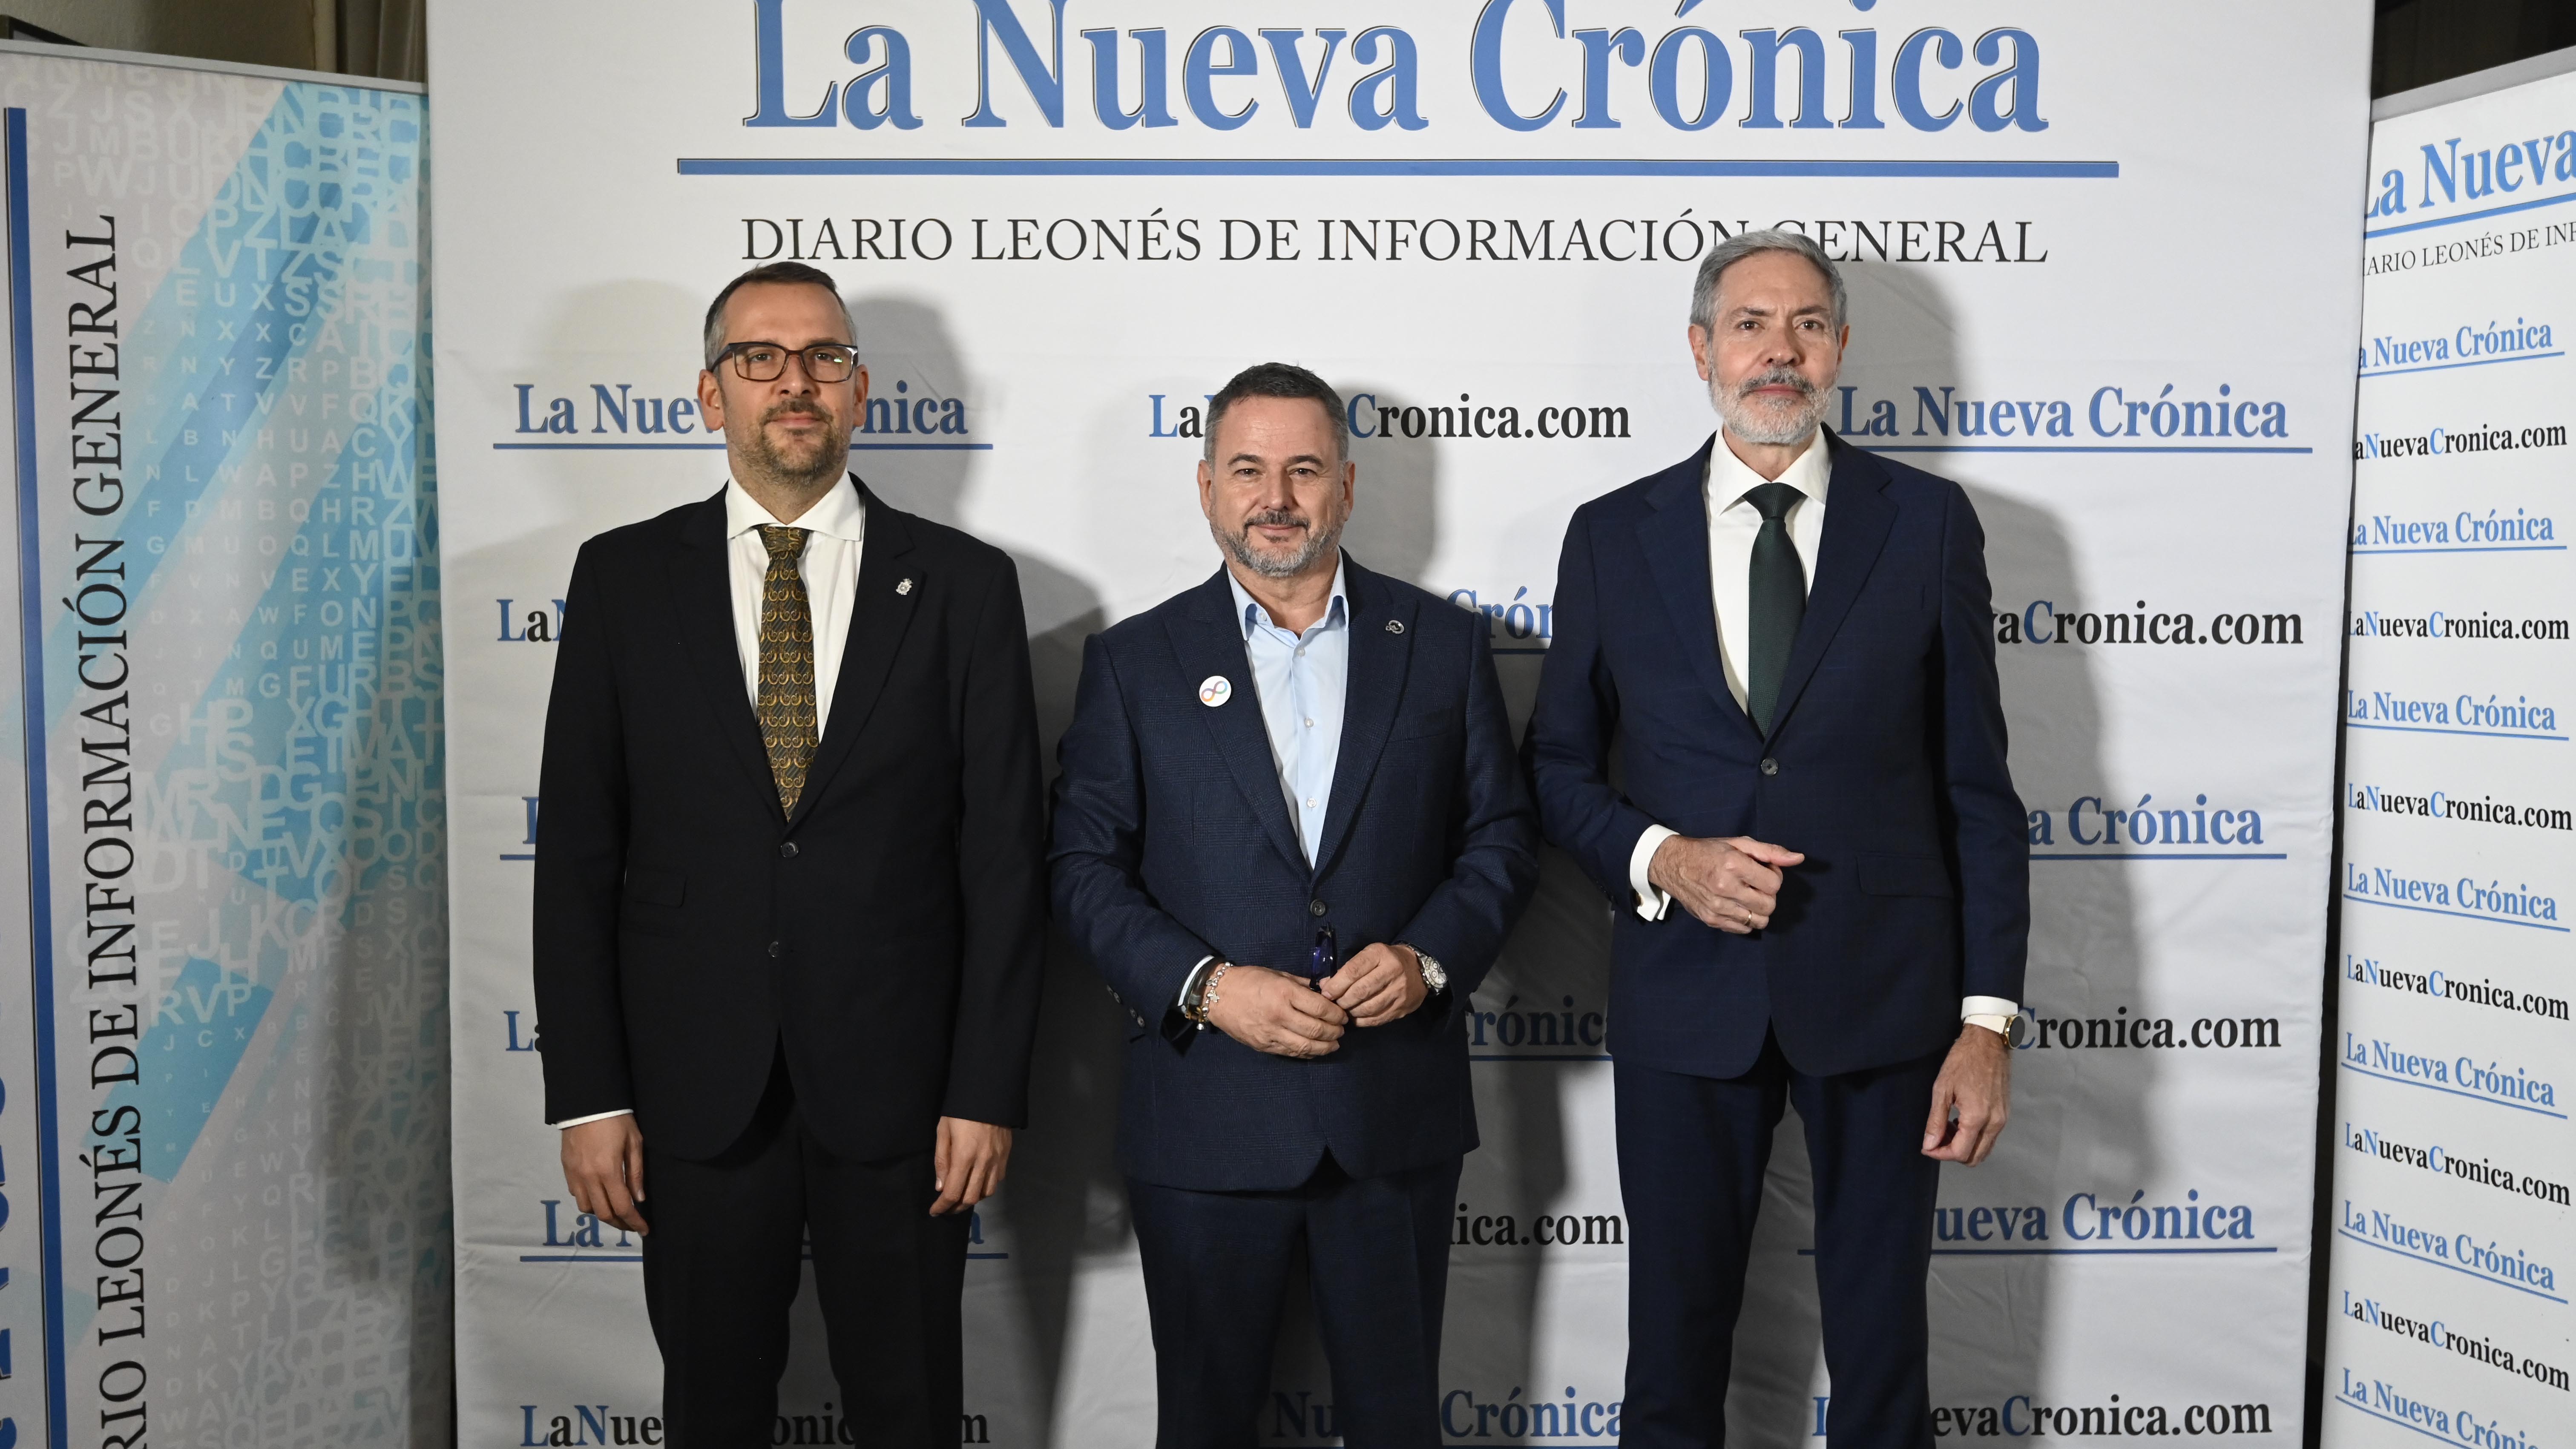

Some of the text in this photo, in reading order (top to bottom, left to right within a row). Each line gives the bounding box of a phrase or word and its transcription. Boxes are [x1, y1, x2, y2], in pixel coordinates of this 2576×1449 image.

[742, 0, 923, 130] La
[961, 0, 1429, 131] Nueva
[741, 218, 952, 260] DIARIO
[971, 207, 1201, 261] LEONÉS
[1219, 219, 1300, 260] DE
[2422, 232, 2503, 267] LEONÉS
[2510, 228, 2539, 253] DE
[66, 215, 124, 516] GENERAL
[2360, 317, 2553, 369] a Nueva Crónica
[513, 379, 970, 435] La Nue nica
[1148, 393, 1632, 440] LaCronica.com
[1835, 383, 2289, 439] La Nueva Crónica
[2355, 422, 2568, 460] aNuevaCronica.com
[2373, 515, 2449, 544] Nueva
[2455, 508, 2554, 543] Crónica
[1993, 600, 2304, 645] aCronica.com
[2348, 690, 2556, 730] La Nueva Crónica
[62, 533, 137, 989] INFORMACIÓN
[2068, 794, 2264, 845] Crónica
[2349, 783, 2573, 831] LaNuevaCronica.com
[2348, 862, 2557, 921] La Nueva Crónica
[2347, 954, 2570, 1021] LaNuevaCronica.com
[89, 1004, 140, 1090] DE
[1466, 994, 1607, 1047] rónic
[2346, 1032, 2555, 1107] La Nueva Crónica
[2346, 1122, 2571, 1206] LaNuevaCronica.com
[79, 1105, 145, 1346] LEONÉS
[539, 1199, 606, 1248] La
[1934, 1189, 2255, 1243] ueva Crónica
[2344, 1199, 2555, 1291] La Nueva Crónica
[2344, 1291, 2570, 1392] LaNuevaCronica.com
[2343, 1367, 2368, 1404] La
[2374, 1380, 2450, 1434] Nueva
